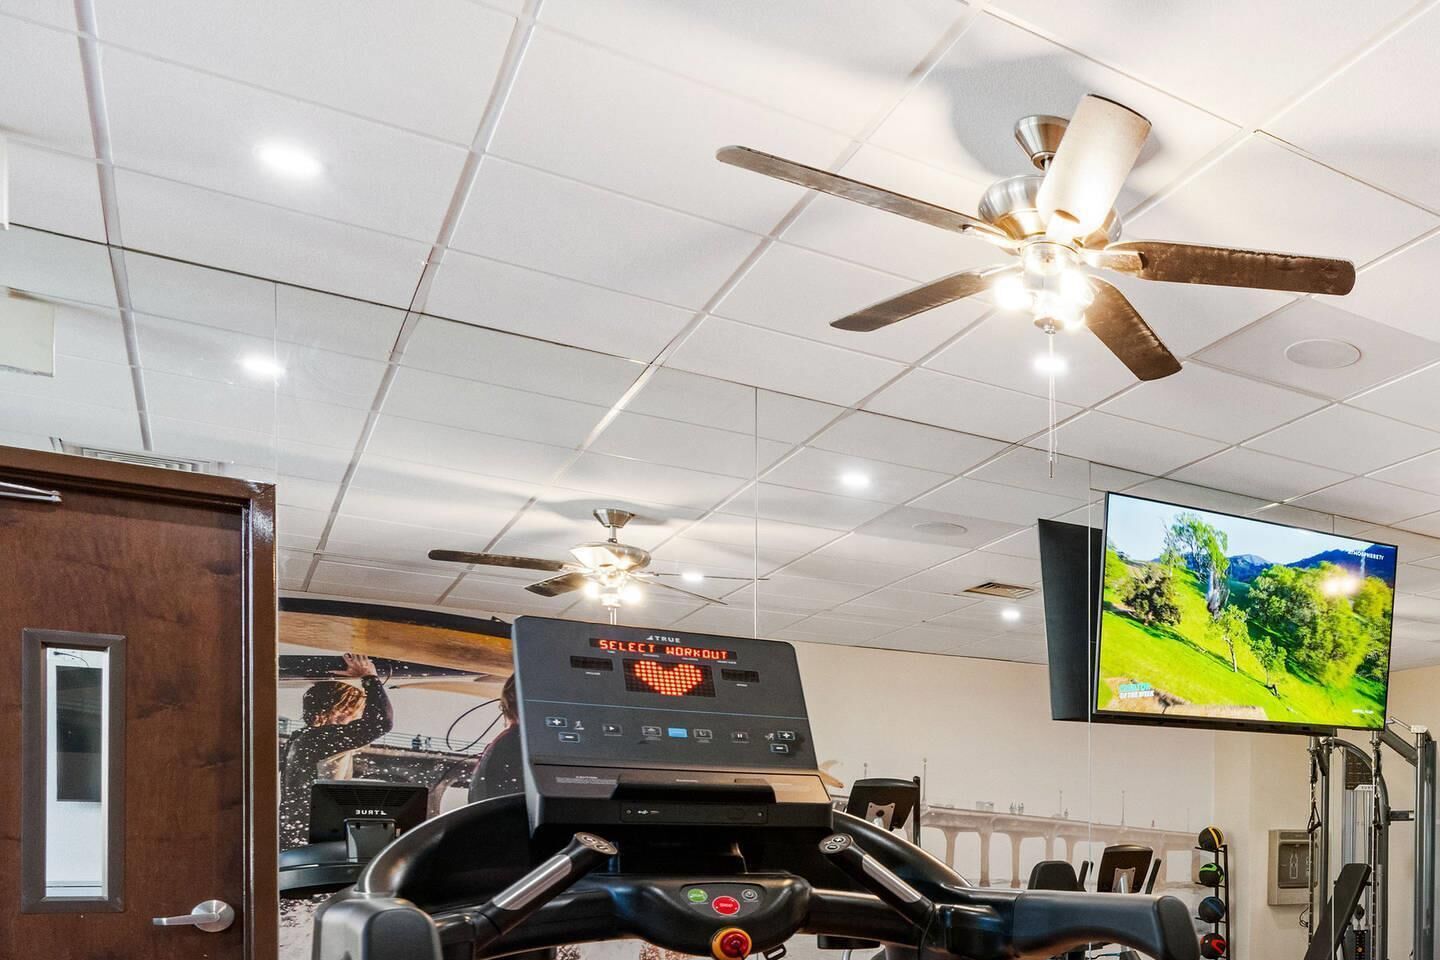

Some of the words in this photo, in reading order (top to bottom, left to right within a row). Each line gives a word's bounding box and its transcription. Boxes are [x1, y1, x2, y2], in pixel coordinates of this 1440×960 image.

[654, 635, 681, 643] TRUE
[599, 639, 655, 653] SELECT
[665, 646, 728, 660] WORKOUT
